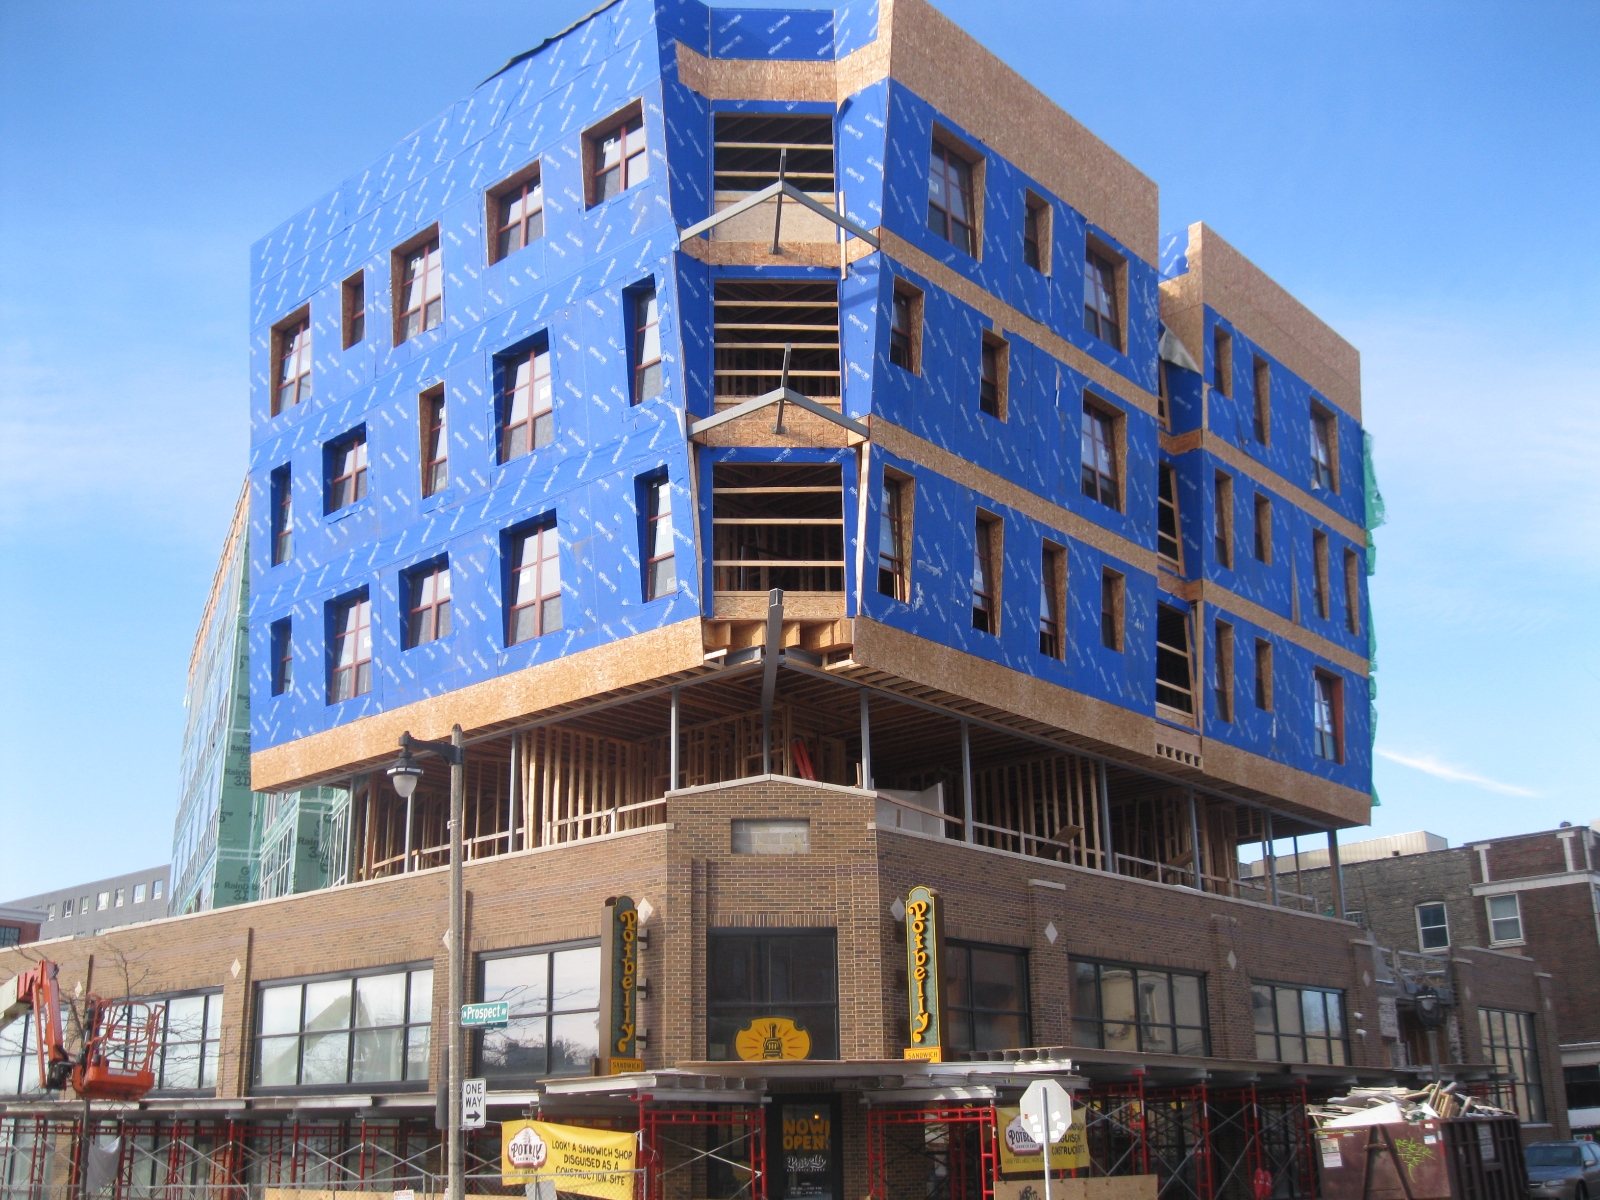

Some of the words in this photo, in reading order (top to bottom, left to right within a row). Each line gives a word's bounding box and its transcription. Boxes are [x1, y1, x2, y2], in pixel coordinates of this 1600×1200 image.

[908, 901, 929, 1043] Potbelly
[618, 910, 638, 1053] Potbelly
[467, 1004, 500, 1022] Prospect
[907, 1051, 938, 1059] SANDWICH
[612, 1061, 641, 1070] SANDWICH
[466, 1083, 482, 1095] ONE
[466, 1096, 483, 1108] WAY
[1008, 1130, 1036, 1146] POTBE
[551, 1140, 571, 1151] LOOK!
[572, 1143, 577, 1152] A
[578, 1143, 613, 1157] SANDWICH
[614, 1148, 633, 1160] SHOP
[563, 1154, 601, 1168] DISGUISED
[602, 1160, 612, 1171] AS
[614, 1161, 619, 1171] A
[609, 1174, 626, 1186] SITE
